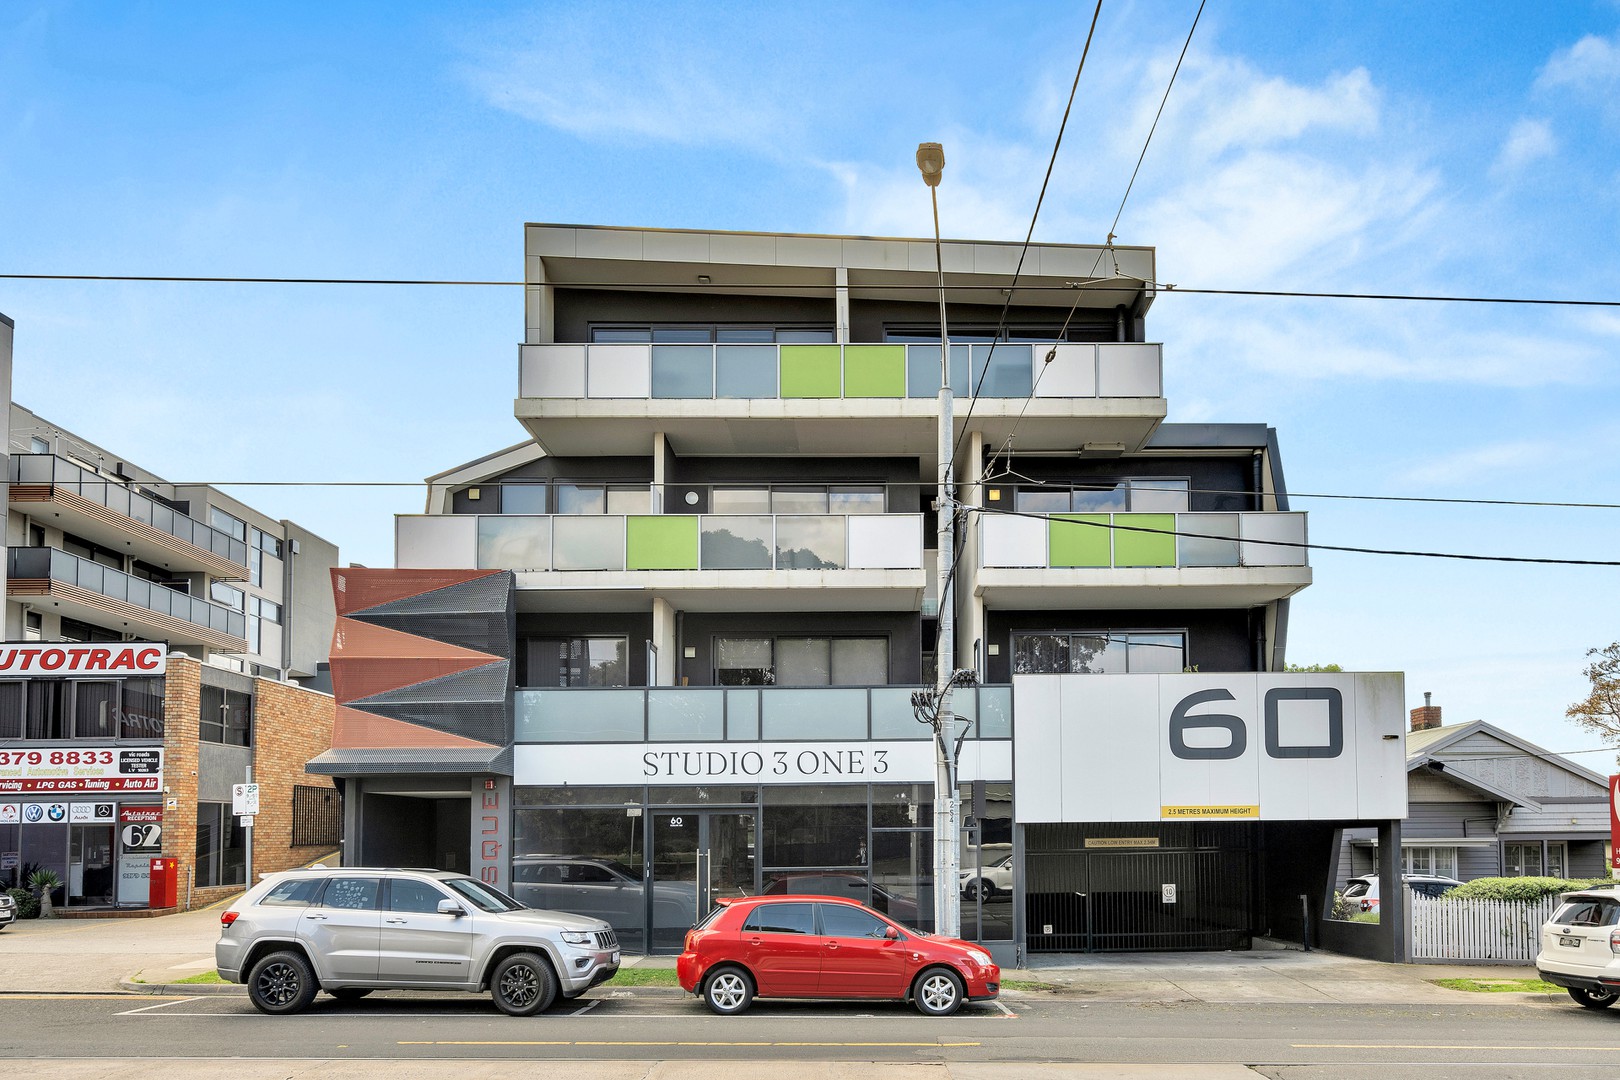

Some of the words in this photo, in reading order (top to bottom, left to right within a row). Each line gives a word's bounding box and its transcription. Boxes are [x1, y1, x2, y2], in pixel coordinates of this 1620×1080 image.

[0, 648, 161, 670] UTOTRAC
[1168, 686, 1343, 760] 60
[49, 751, 114, 765] 8833
[643, 751, 764, 776] STUDIO
[773, 751, 788, 775] 3
[796, 750, 865, 775] ONE
[873, 750, 889, 774] 3
[36, 781, 55, 789] LPG
[84, 779, 110, 790] Tuning
[123, 779, 143, 789] Auto
[144, 778, 157, 788] Air
[1229, 807, 1251, 815] HEIGHT
[670, 817, 683, 825] 60
[122, 824, 162, 847] 62
